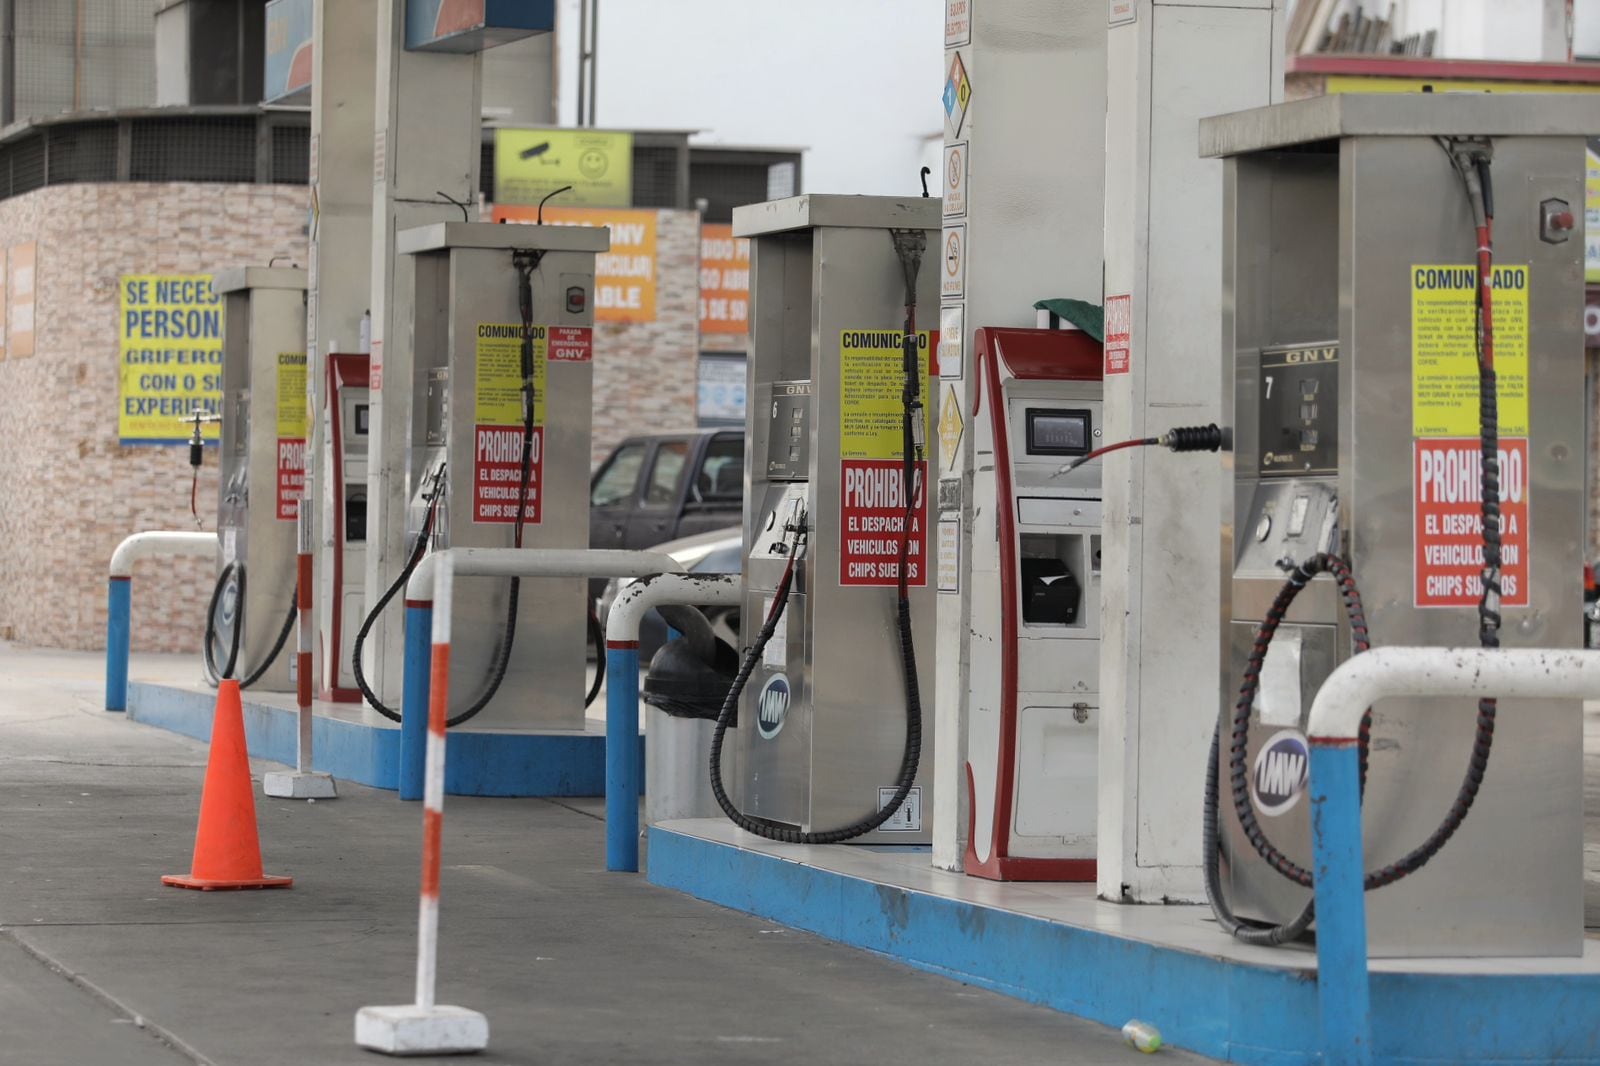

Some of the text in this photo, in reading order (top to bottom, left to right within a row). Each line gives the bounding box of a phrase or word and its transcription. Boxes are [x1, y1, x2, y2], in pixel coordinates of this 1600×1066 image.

[954, 63, 960, 82] 4
[947, 87, 952, 106] 1
[960, 84, 966, 102] 0
[1415, 269, 1525, 289] COMUNADO
[127, 281, 149, 304] SE
[126, 310, 220, 339] PERSON
[478, 325, 545, 340] COMUNICDO
[559, 328, 582, 336] PARADA
[842, 332, 927, 349] COMUNICO
[556, 348, 585, 358] GNV
[1285, 348, 1335, 363] GNV
[140, 374, 176, 391] CON
[184, 375, 196, 391] O
[1265, 376, 1274, 399] 7
[772, 401, 778, 419] 6
[477, 430, 540, 464] PROHIBIO
[480, 468, 489, 481] EL
[530, 469, 537, 482] A
[1420, 448, 1522, 504] PROHIDO
[478, 486, 520, 500] VEHICULOS
[845, 467, 923, 509] PROHIBIO
[479, 504, 502, 517] CHIPS
[848, 516, 919, 532] EL DESPACH A
[1425, 514, 1518, 535] EL DESPAO A
[847, 539, 898, 555] VEHICULOS
[848, 562, 876, 578] CHIPS
[1426, 575, 1463, 597] CHIPS
